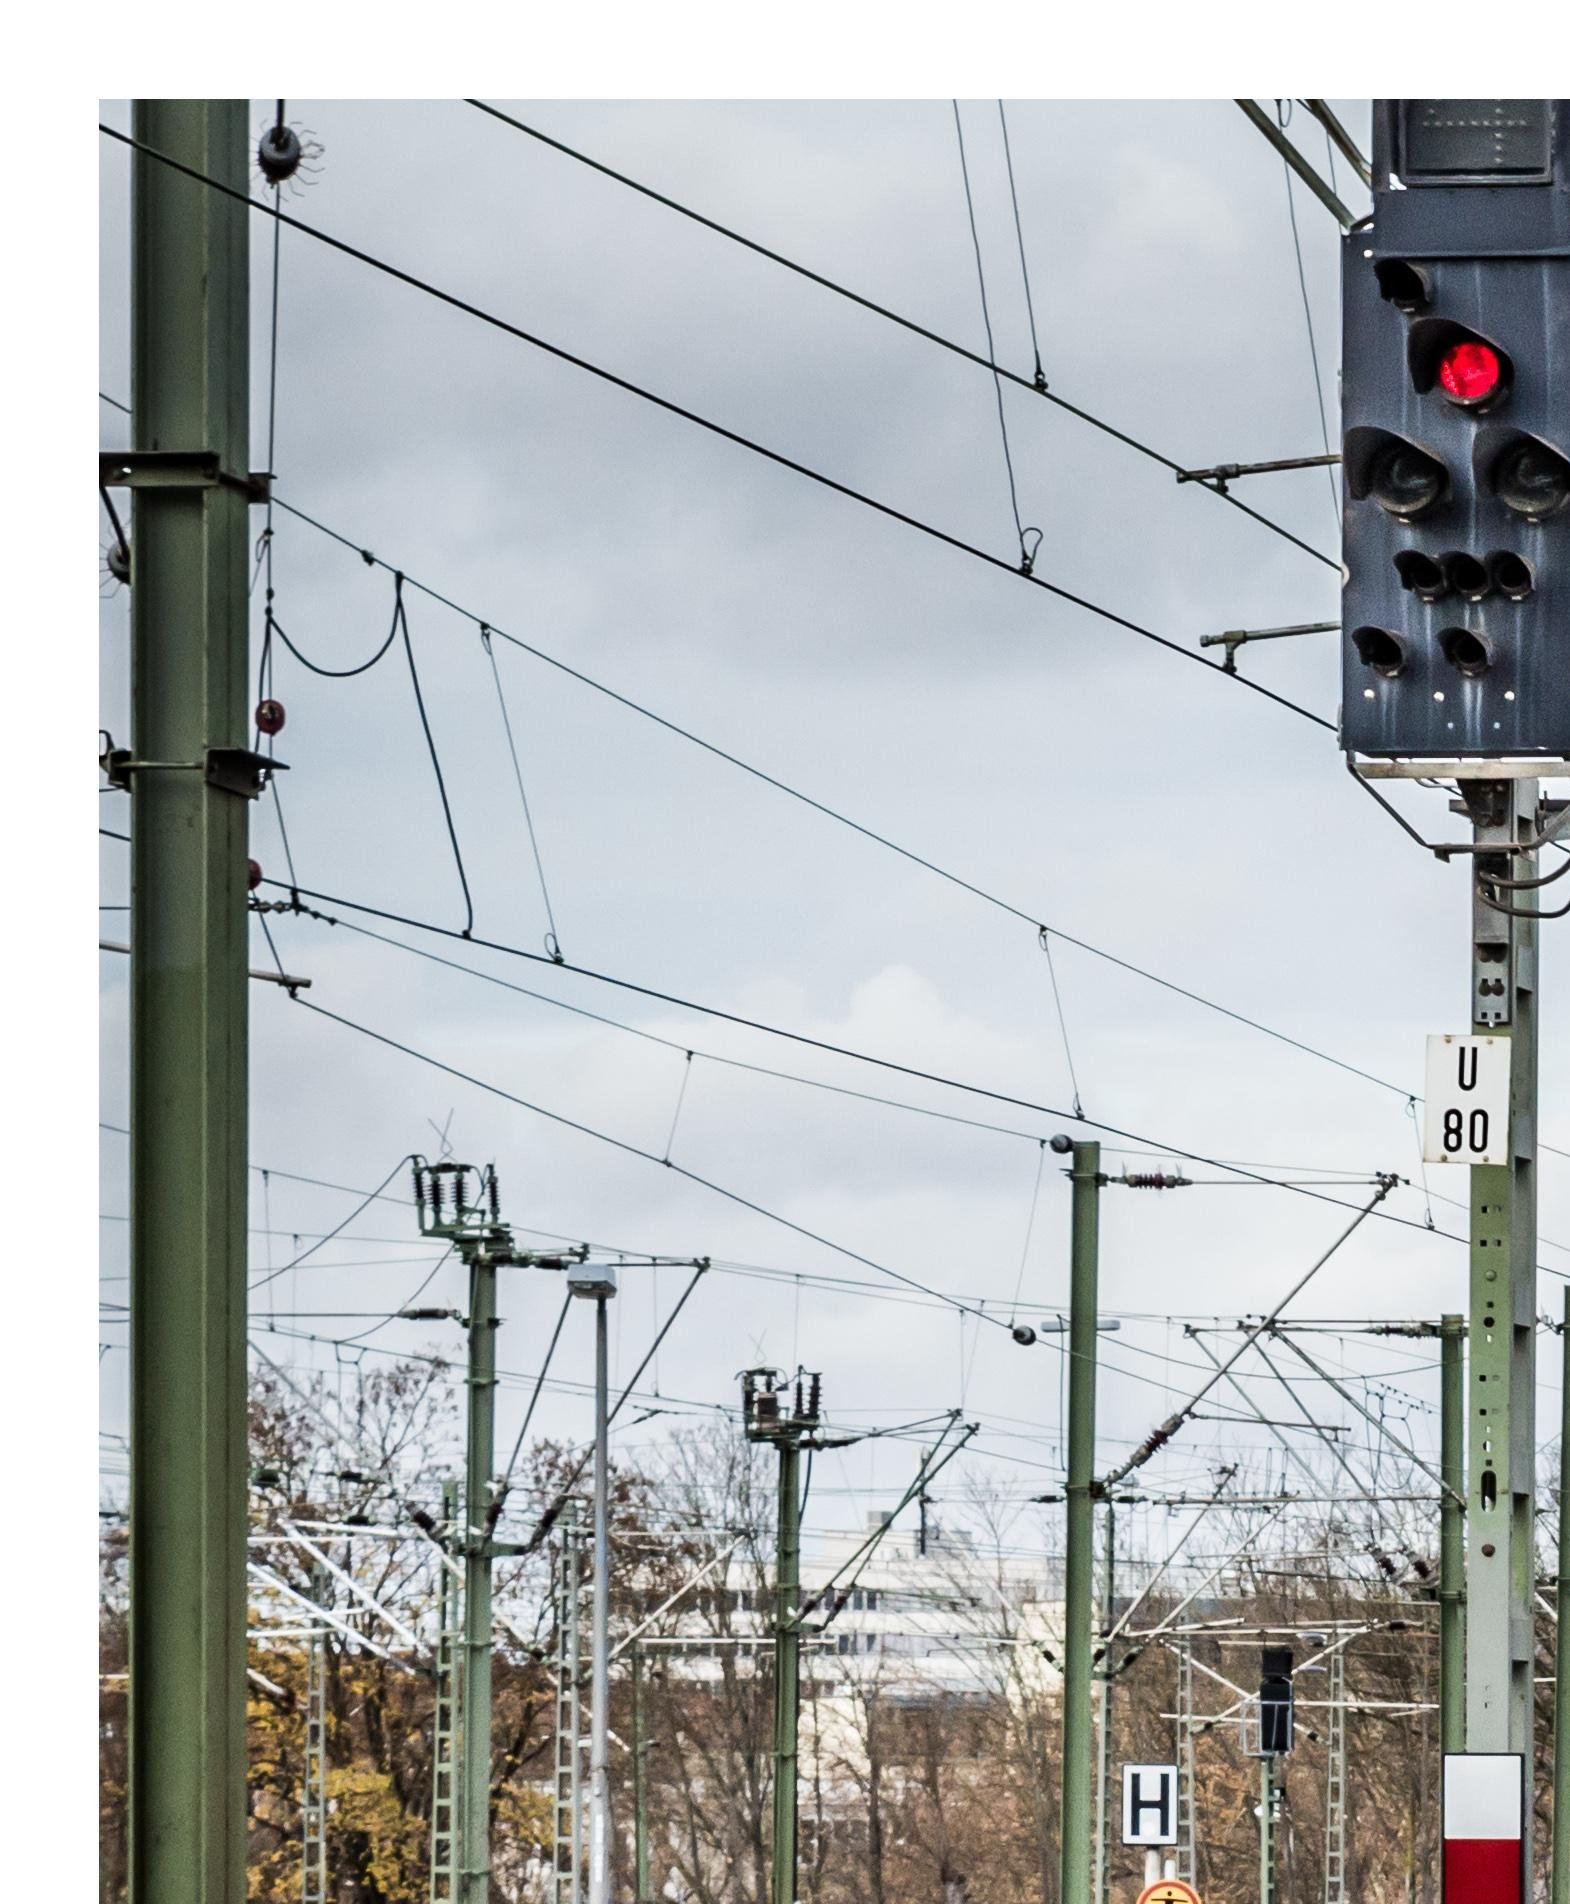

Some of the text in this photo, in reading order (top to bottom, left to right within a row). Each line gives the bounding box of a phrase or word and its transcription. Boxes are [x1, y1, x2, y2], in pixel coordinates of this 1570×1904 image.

[1458, 1046, 1478, 1091] U
[1443, 1108, 1489, 1153] 80
[1130, 1772, 1170, 1837] H
